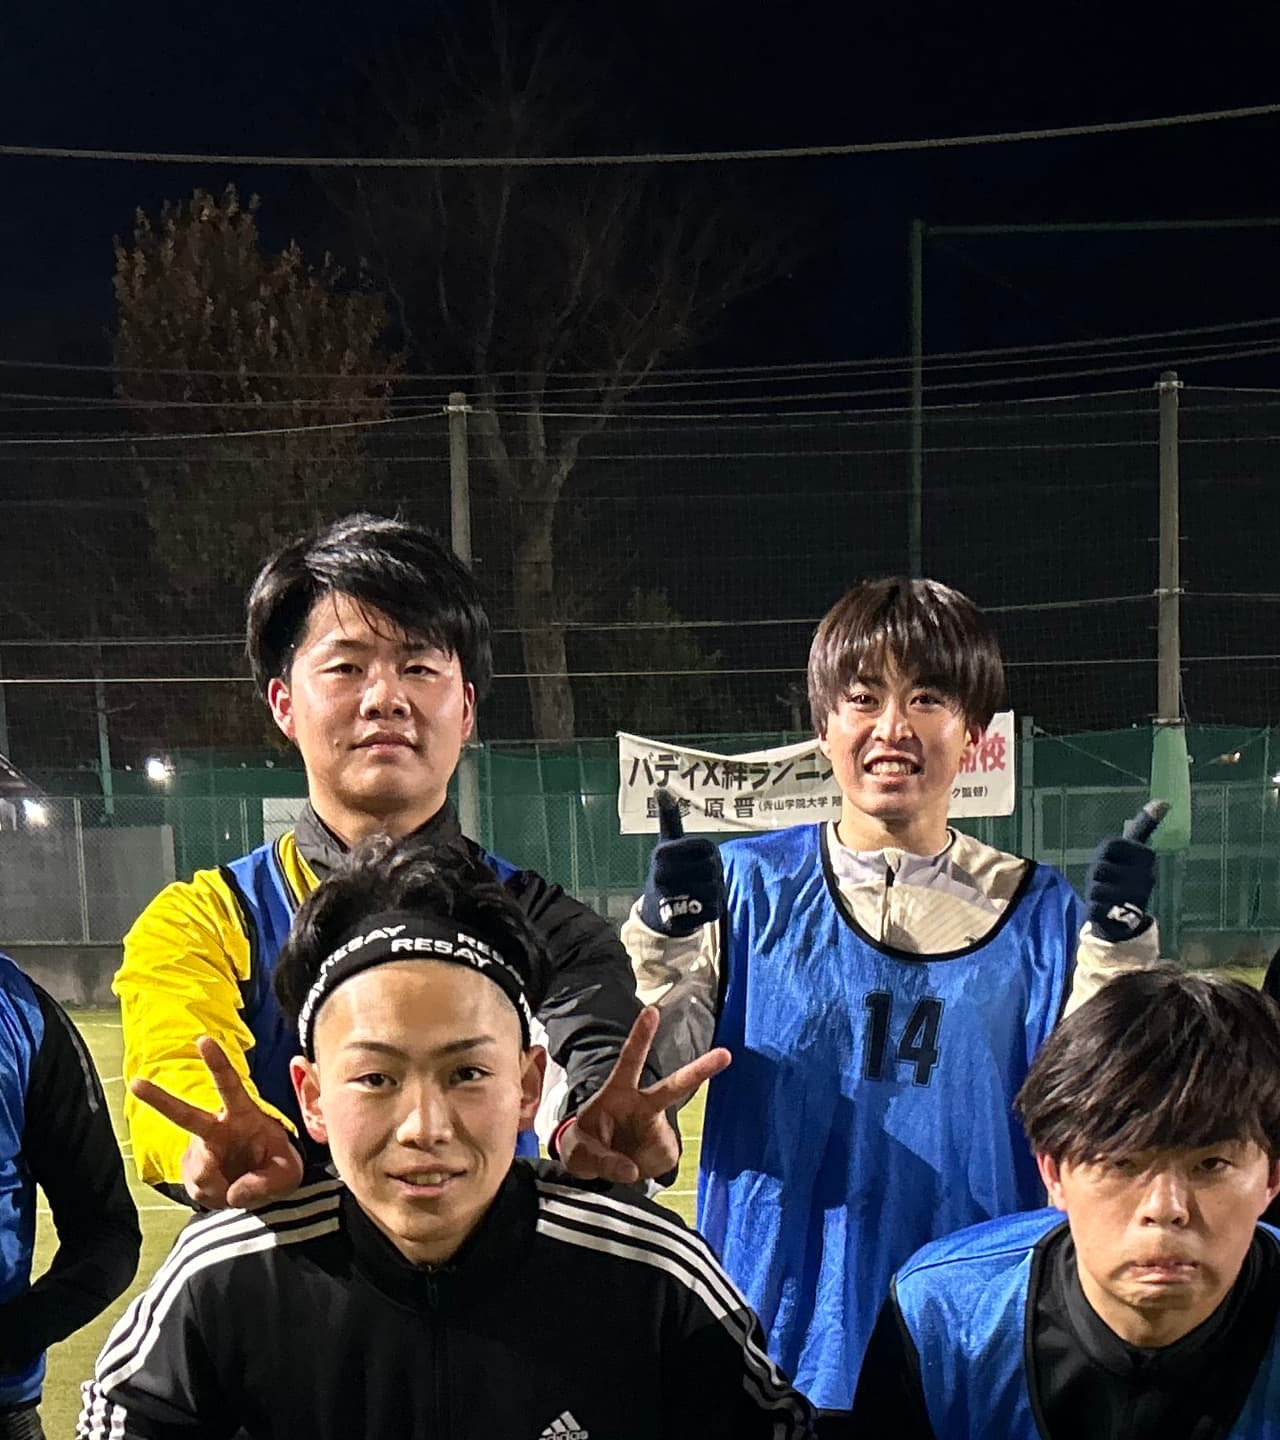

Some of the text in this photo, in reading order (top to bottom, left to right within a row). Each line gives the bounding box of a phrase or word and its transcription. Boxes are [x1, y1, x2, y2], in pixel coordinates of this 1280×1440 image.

[705, 798, 725, 818] 原
[734, 797, 755, 818] 晋
[391, 937, 492, 968] RESAY
[863, 989, 945, 1088] 14
